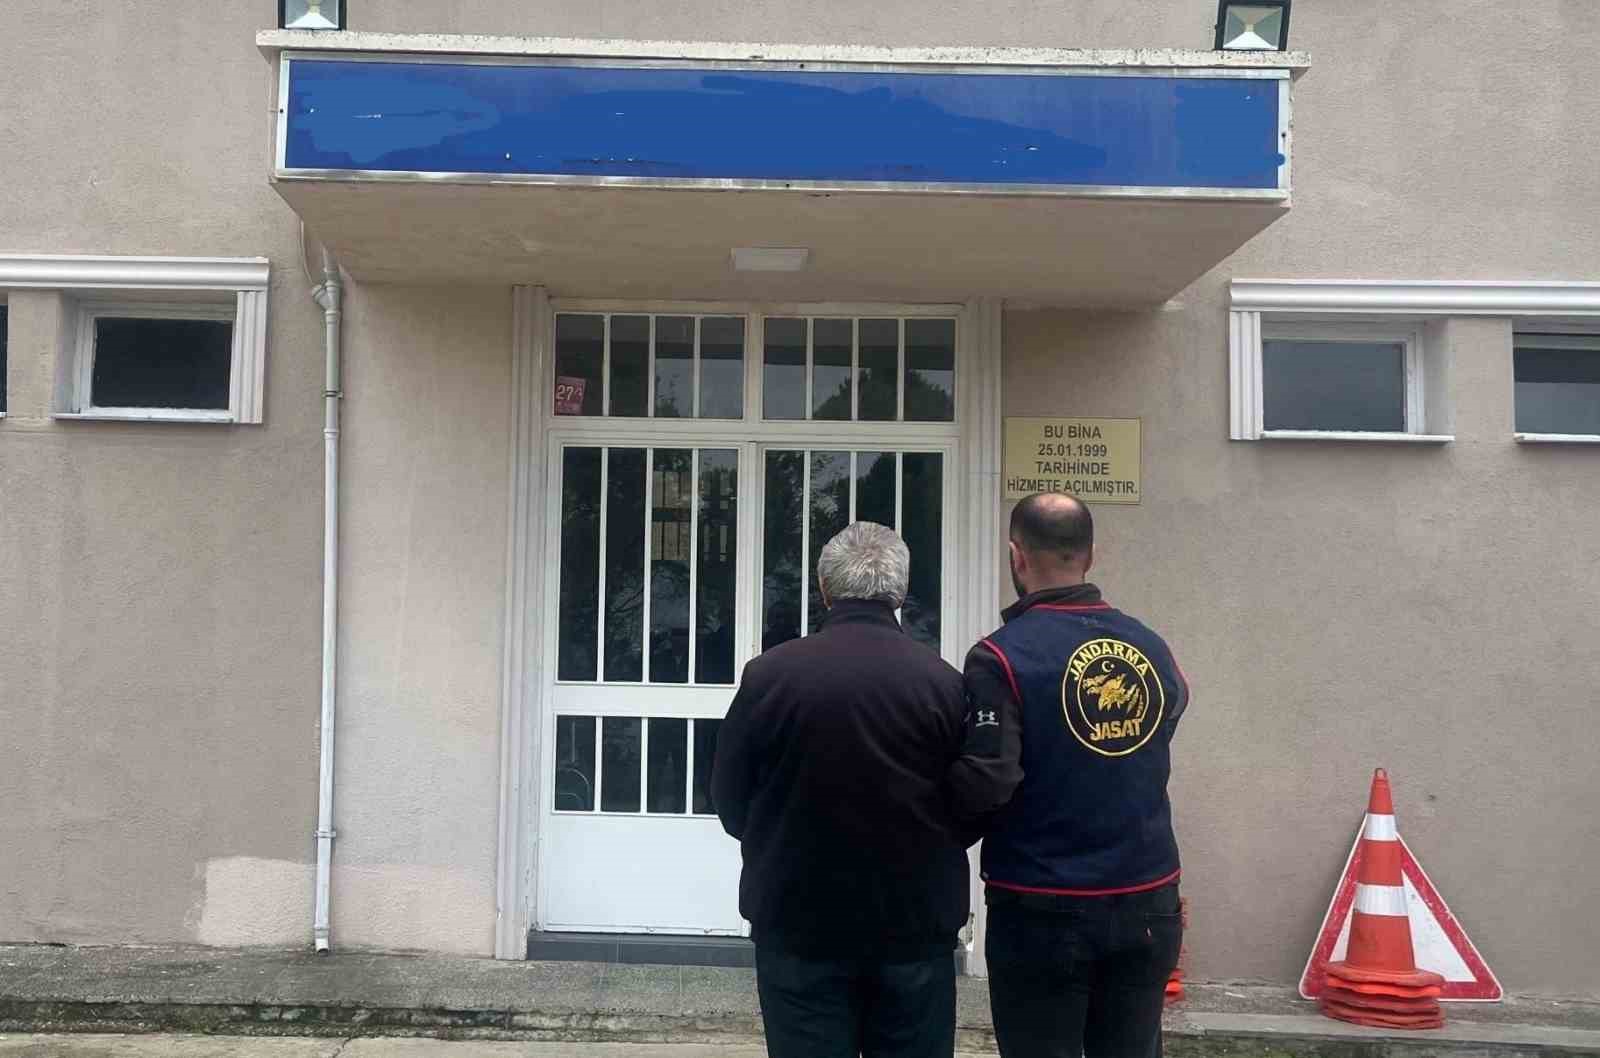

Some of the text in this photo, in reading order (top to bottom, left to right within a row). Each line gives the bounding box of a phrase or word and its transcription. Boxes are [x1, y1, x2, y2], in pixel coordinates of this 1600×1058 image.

[1044, 423, 1102, 439] BU BİNA
[1038, 443, 1107, 457] 25.01.1999
[1035, 458, 1111, 475] TARİHİNDE
[1007, 475, 1138, 496] HİZMETE AÇILMIŞTIR.
[1070, 642, 1149, 681] JANDARMA
[1089, 718, 1142, 741] JASAT
